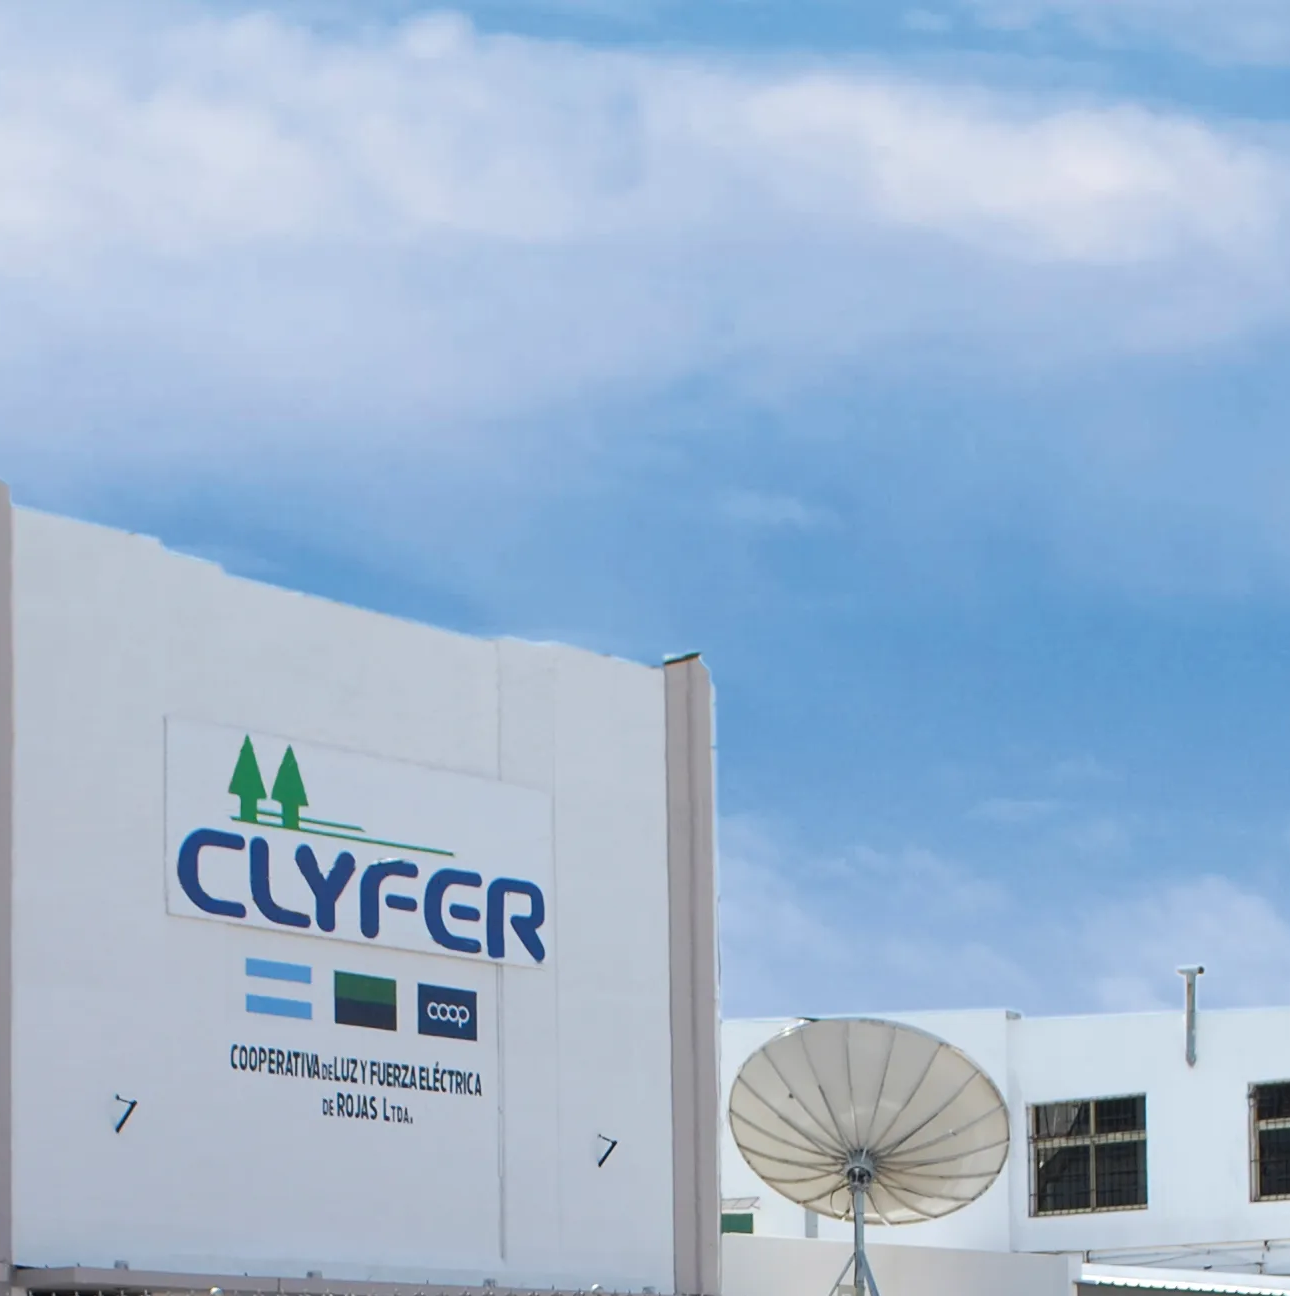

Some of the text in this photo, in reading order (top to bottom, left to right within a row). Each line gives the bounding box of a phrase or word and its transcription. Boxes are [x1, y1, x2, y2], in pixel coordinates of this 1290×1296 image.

[176, 827, 546, 963] CLYFER
[427, 1001, 470, 1028] coop
[229, 1044, 320, 1079] COOPERATIVA
[334, 1056, 358, 1084] LUZ
[359, 1060, 368, 1085] Y
[370, 1061, 418, 1090] FUERZA
[418, 1061, 482, 1097] ELÉCTRICA
[337, 1092, 378, 1121] ROJAS
